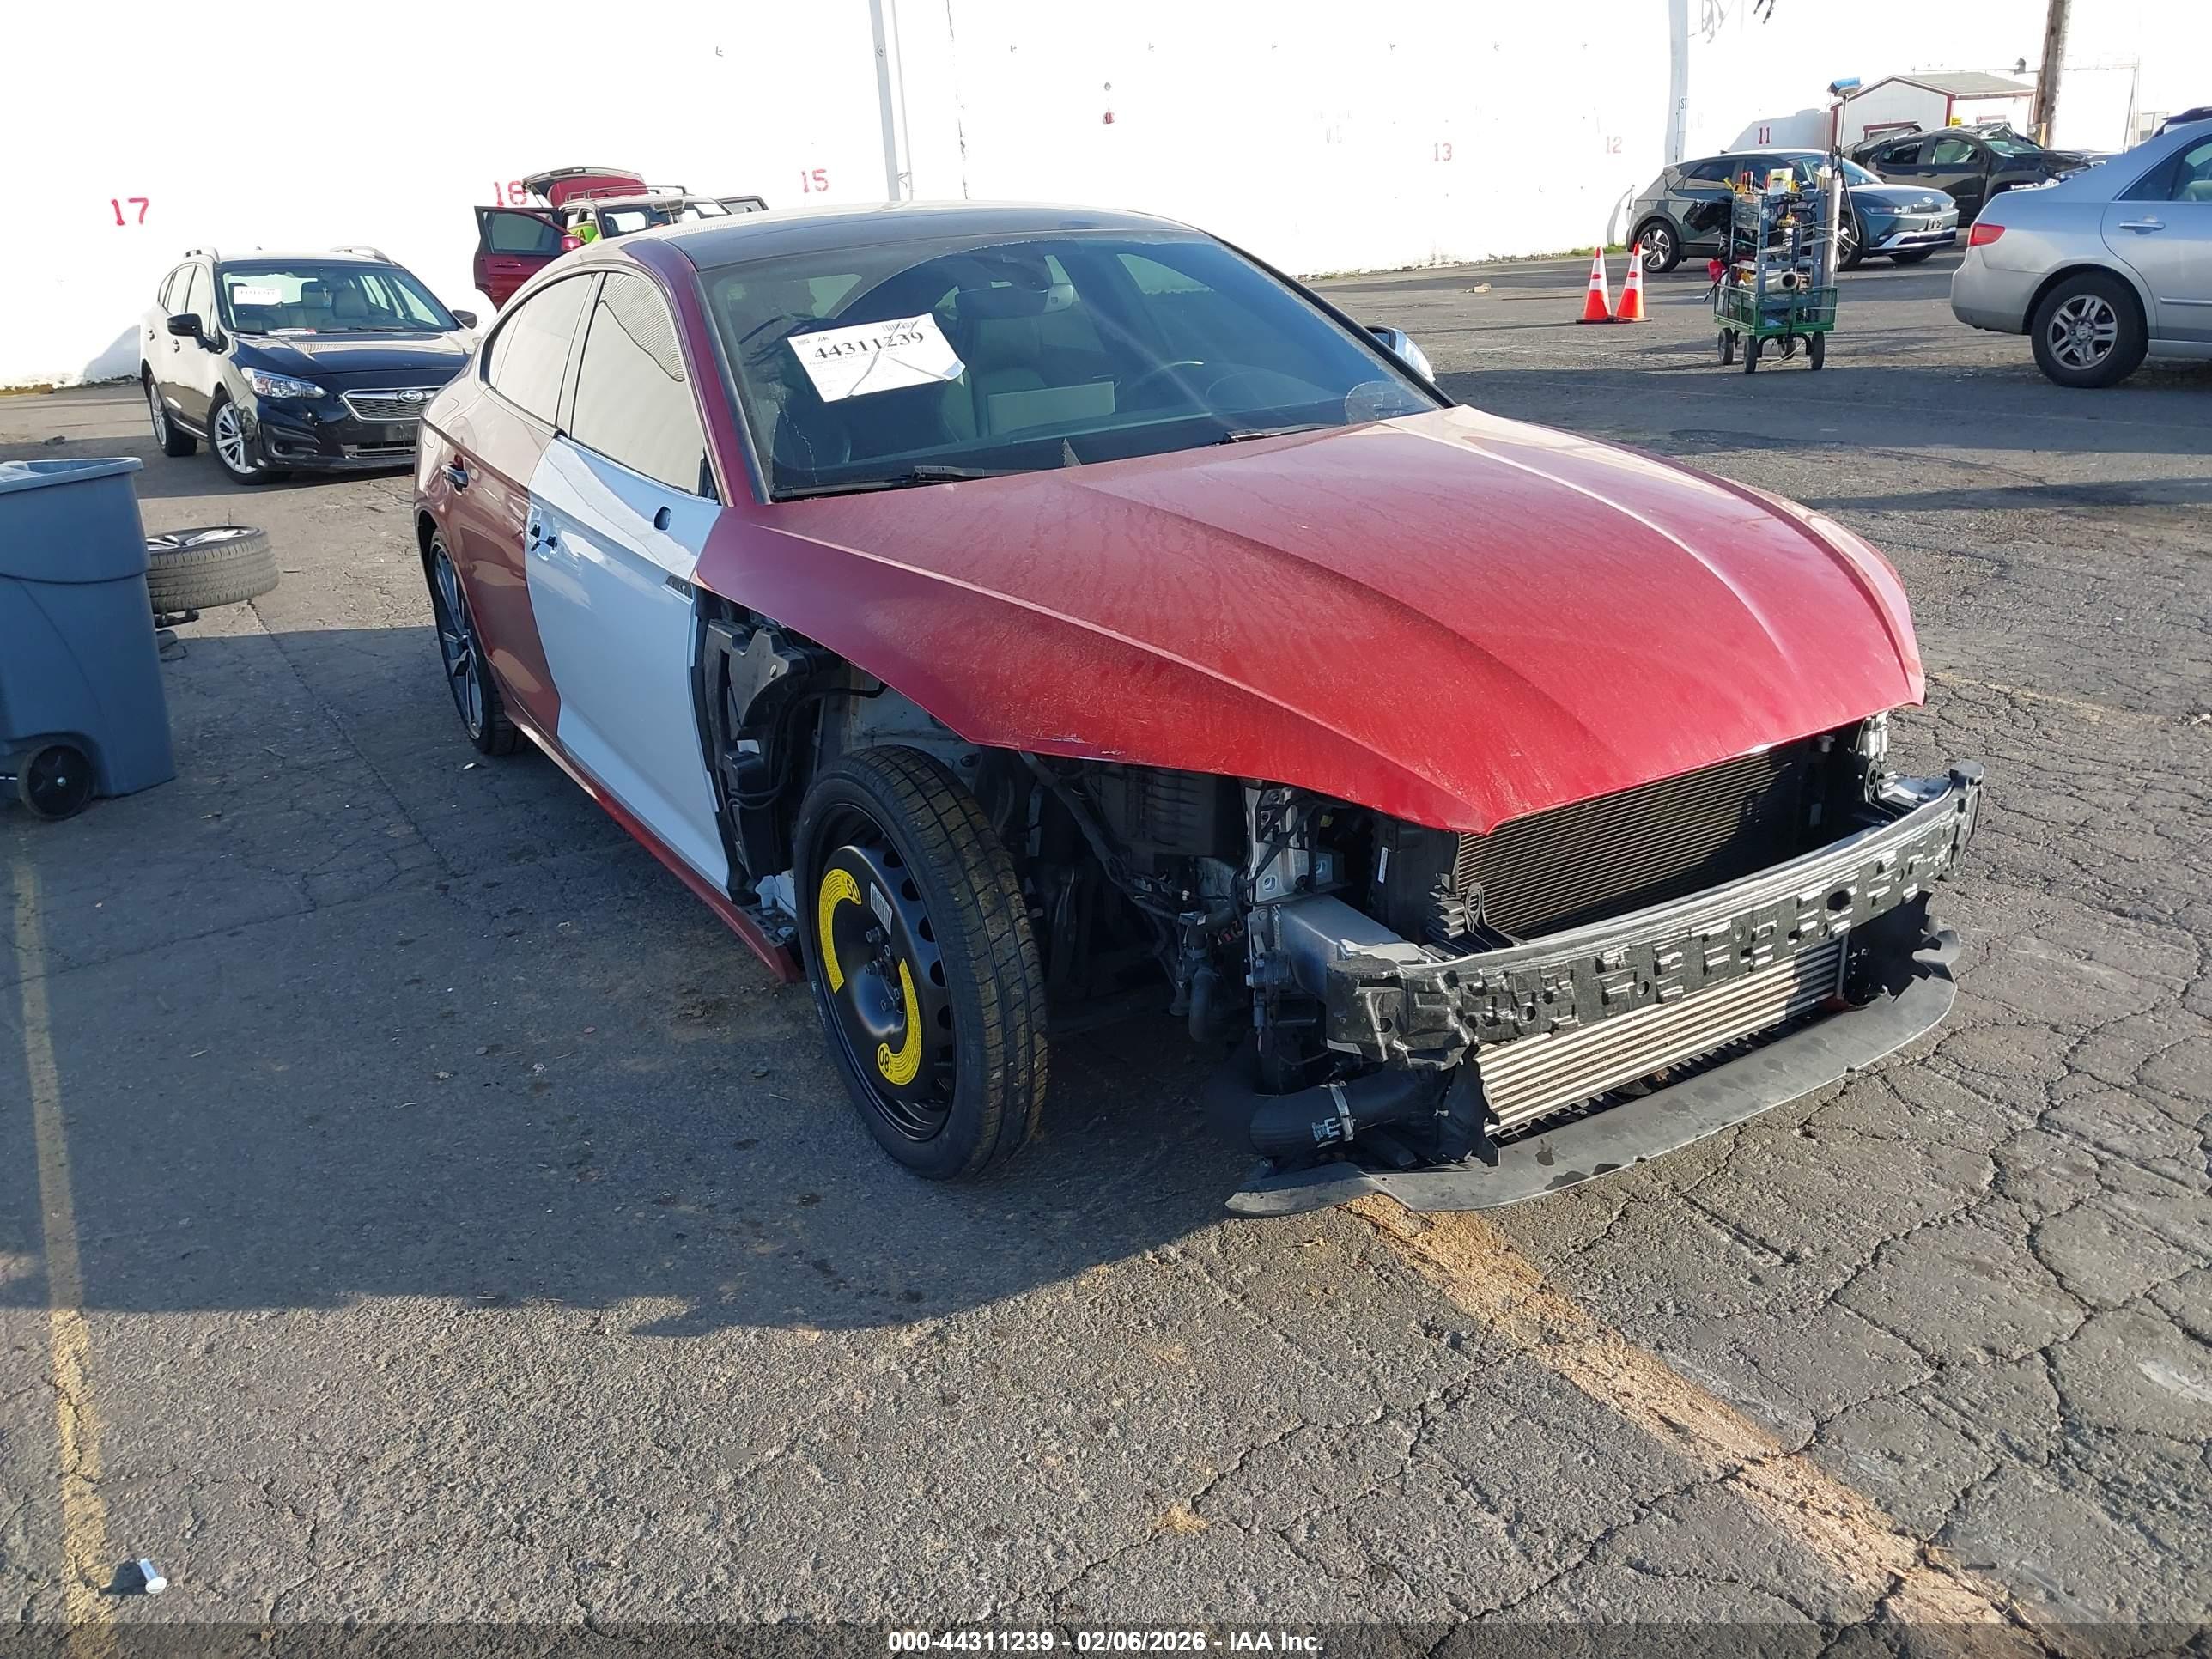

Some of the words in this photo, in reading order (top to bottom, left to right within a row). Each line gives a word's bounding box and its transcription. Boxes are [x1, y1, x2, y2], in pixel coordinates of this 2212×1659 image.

[1606, 136, 1622, 154] 12
[1759, 127, 1771, 144] 11
[1434, 142, 1452, 161] 13
[801, 169, 829, 193] 15
[111, 198, 149, 226] 17
[814, 331, 925, 359] 44311239
[846, 878, 860, 901] 50
[879, 1047, 890, 1072] 80
